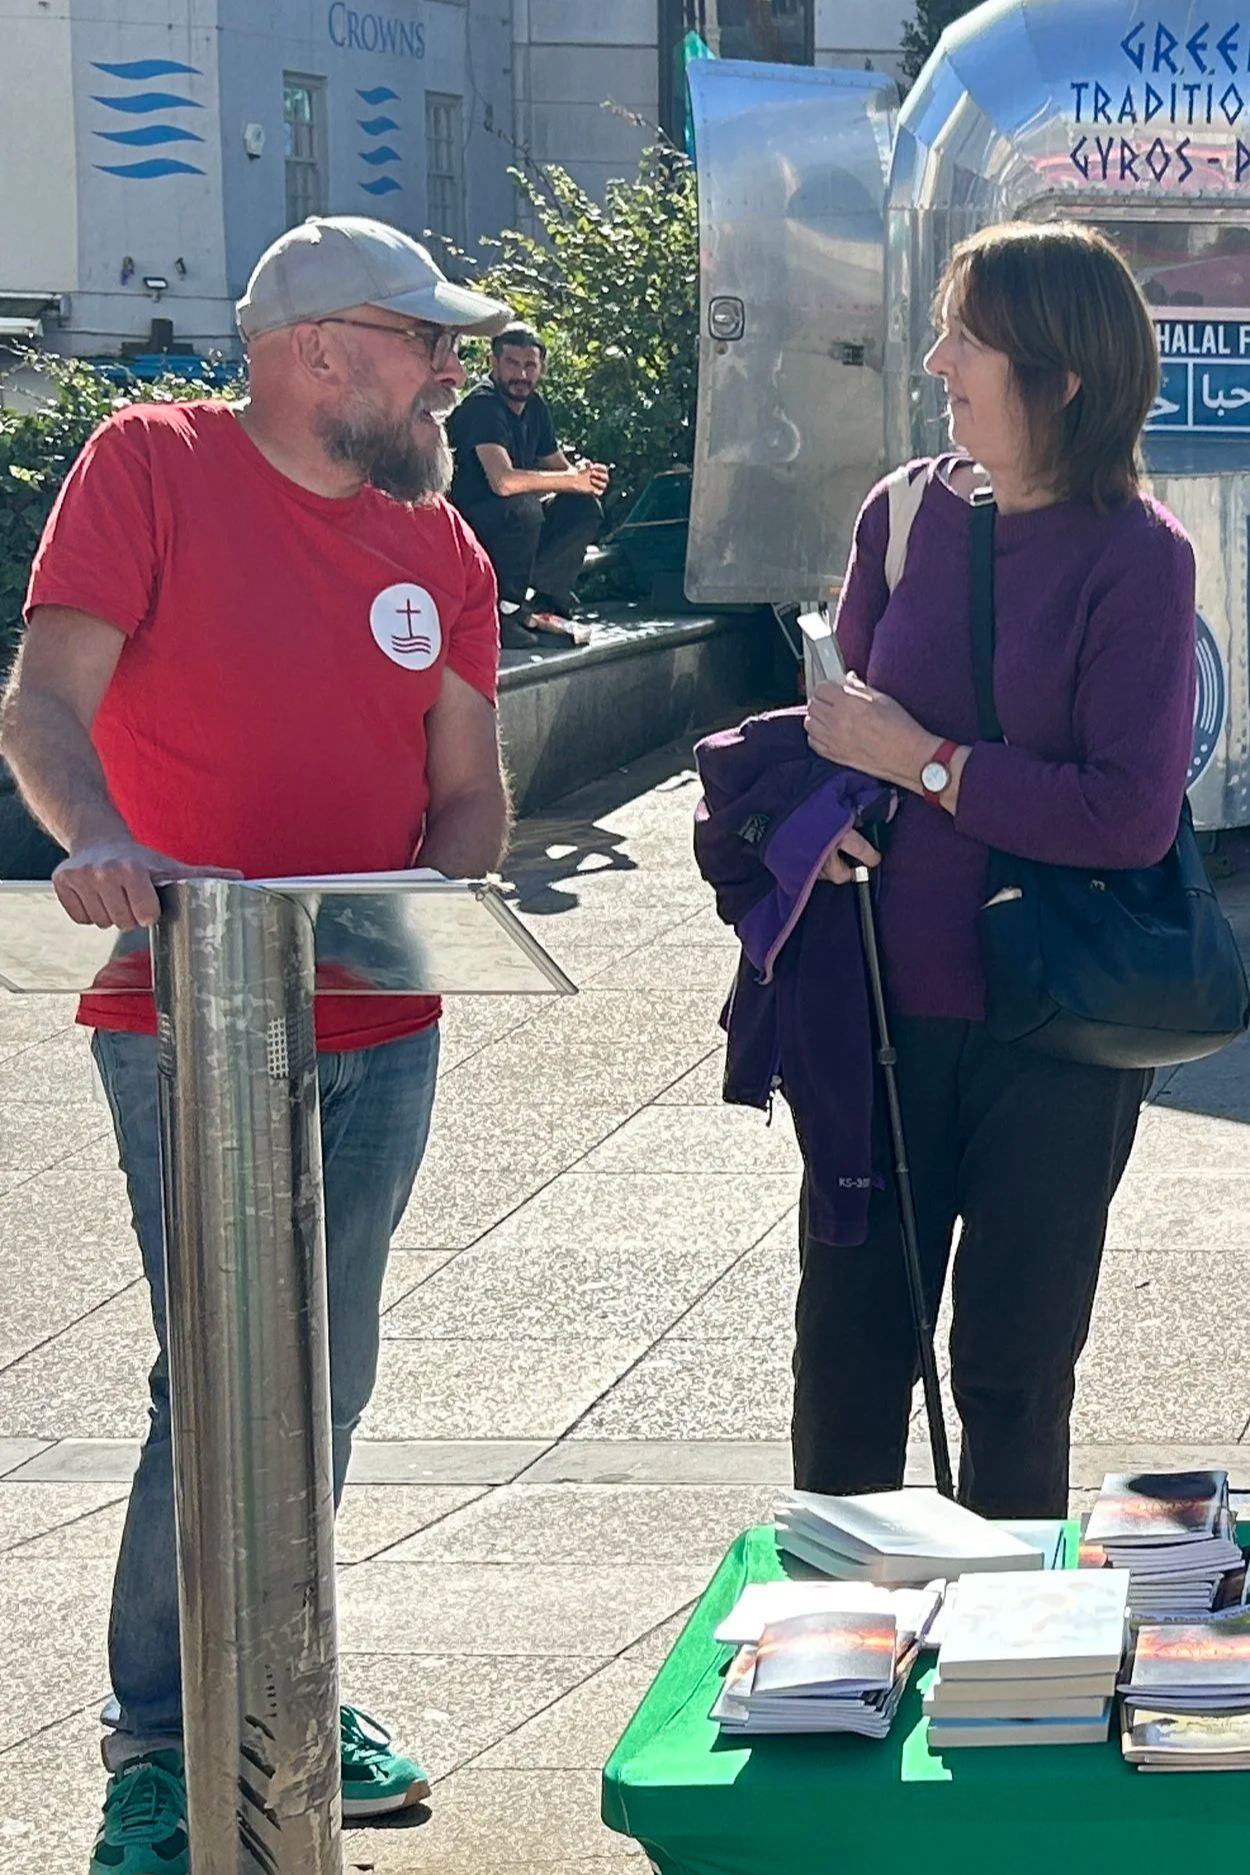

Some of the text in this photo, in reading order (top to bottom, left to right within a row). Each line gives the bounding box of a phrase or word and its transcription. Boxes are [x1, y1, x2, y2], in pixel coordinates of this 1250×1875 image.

[328, 1, 425, 59] CROWNS
[1070, 136, 1193, 183] GYROS
[1157, 323, 1231, 354] HALAL
